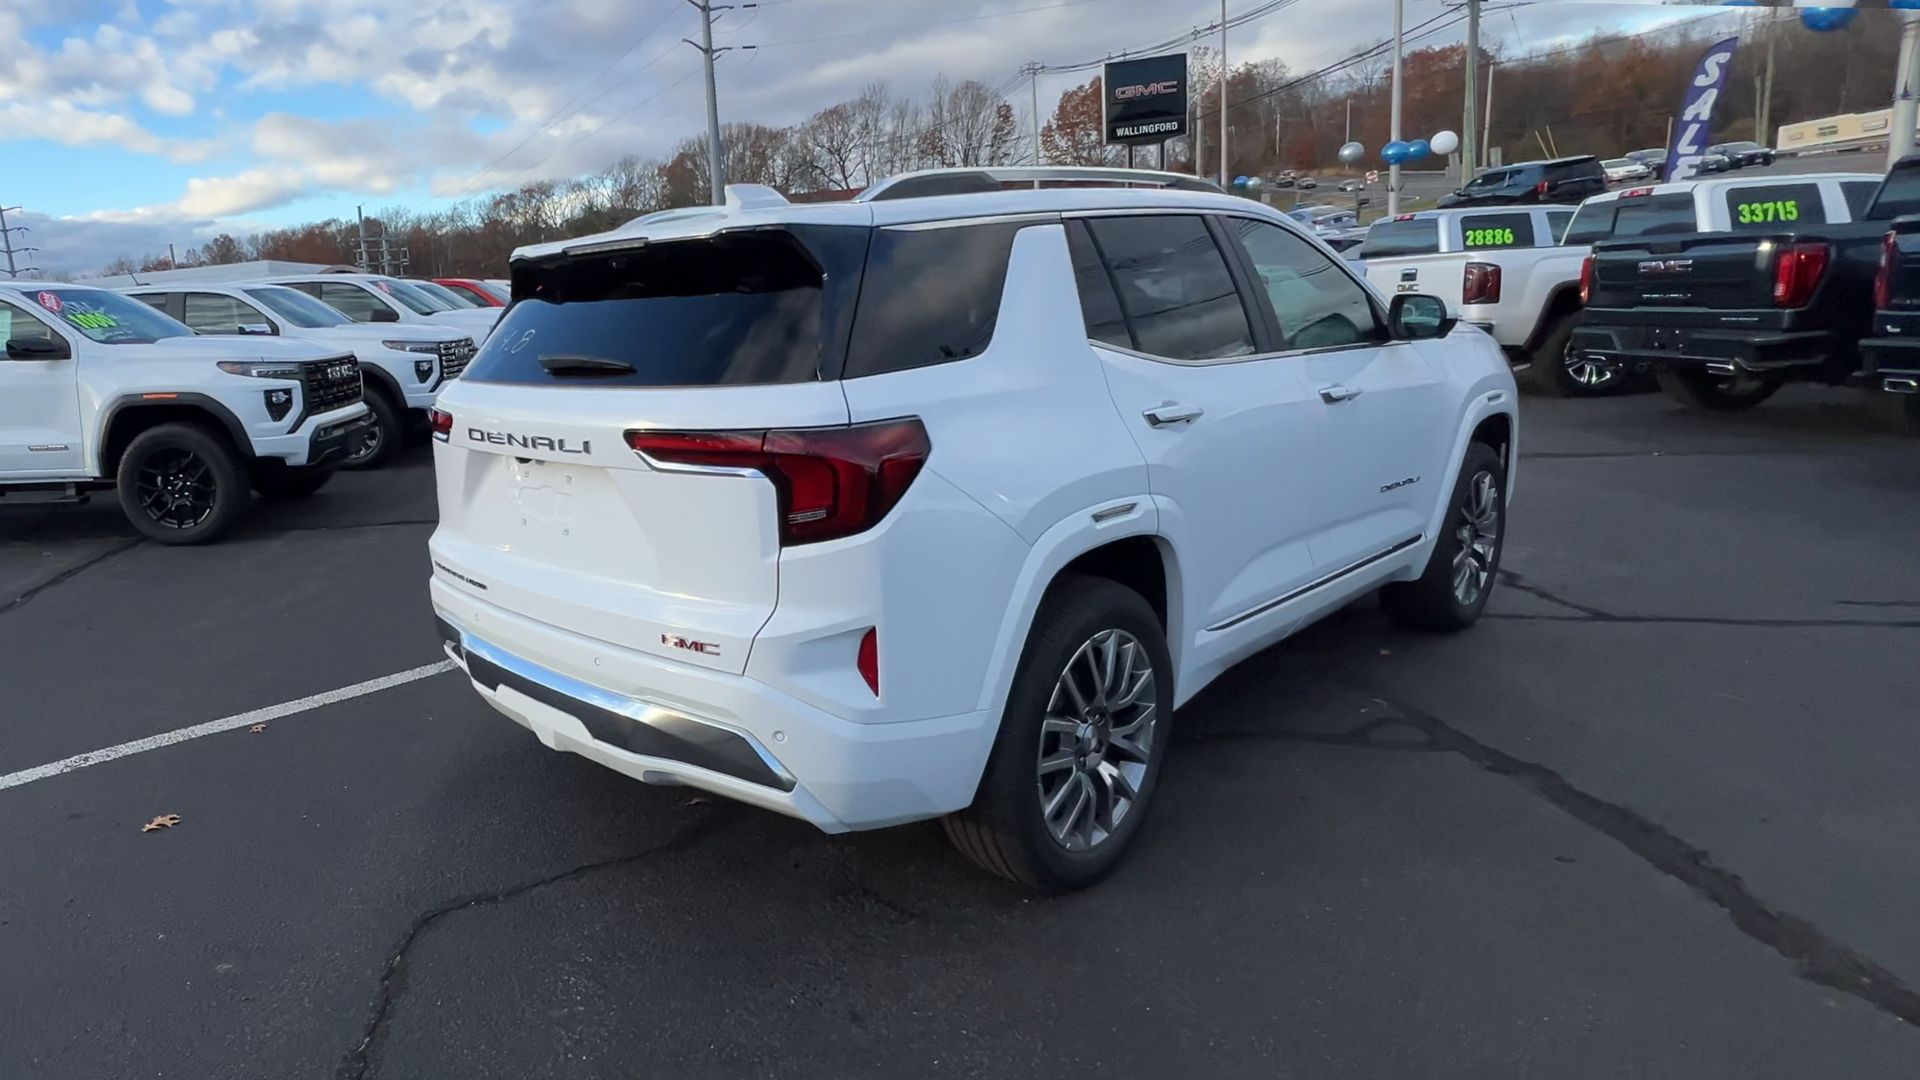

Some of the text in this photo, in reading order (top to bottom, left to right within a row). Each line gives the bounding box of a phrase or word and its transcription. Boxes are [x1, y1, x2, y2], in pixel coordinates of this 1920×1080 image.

[1115, 81, 1178, 100] GMC
[1116, 121, 1178, 137] WALLINGFORD
[1738, 200, 1799, 224] 33715
[1465, 228, 1514, 246] 28886
[1397, 284, 1419, 292] GMC
[468, 427, 592, 455] DENALI
[1379, 475, 1421, 494] DENALI
[661, 633, 721, 657] GMC
